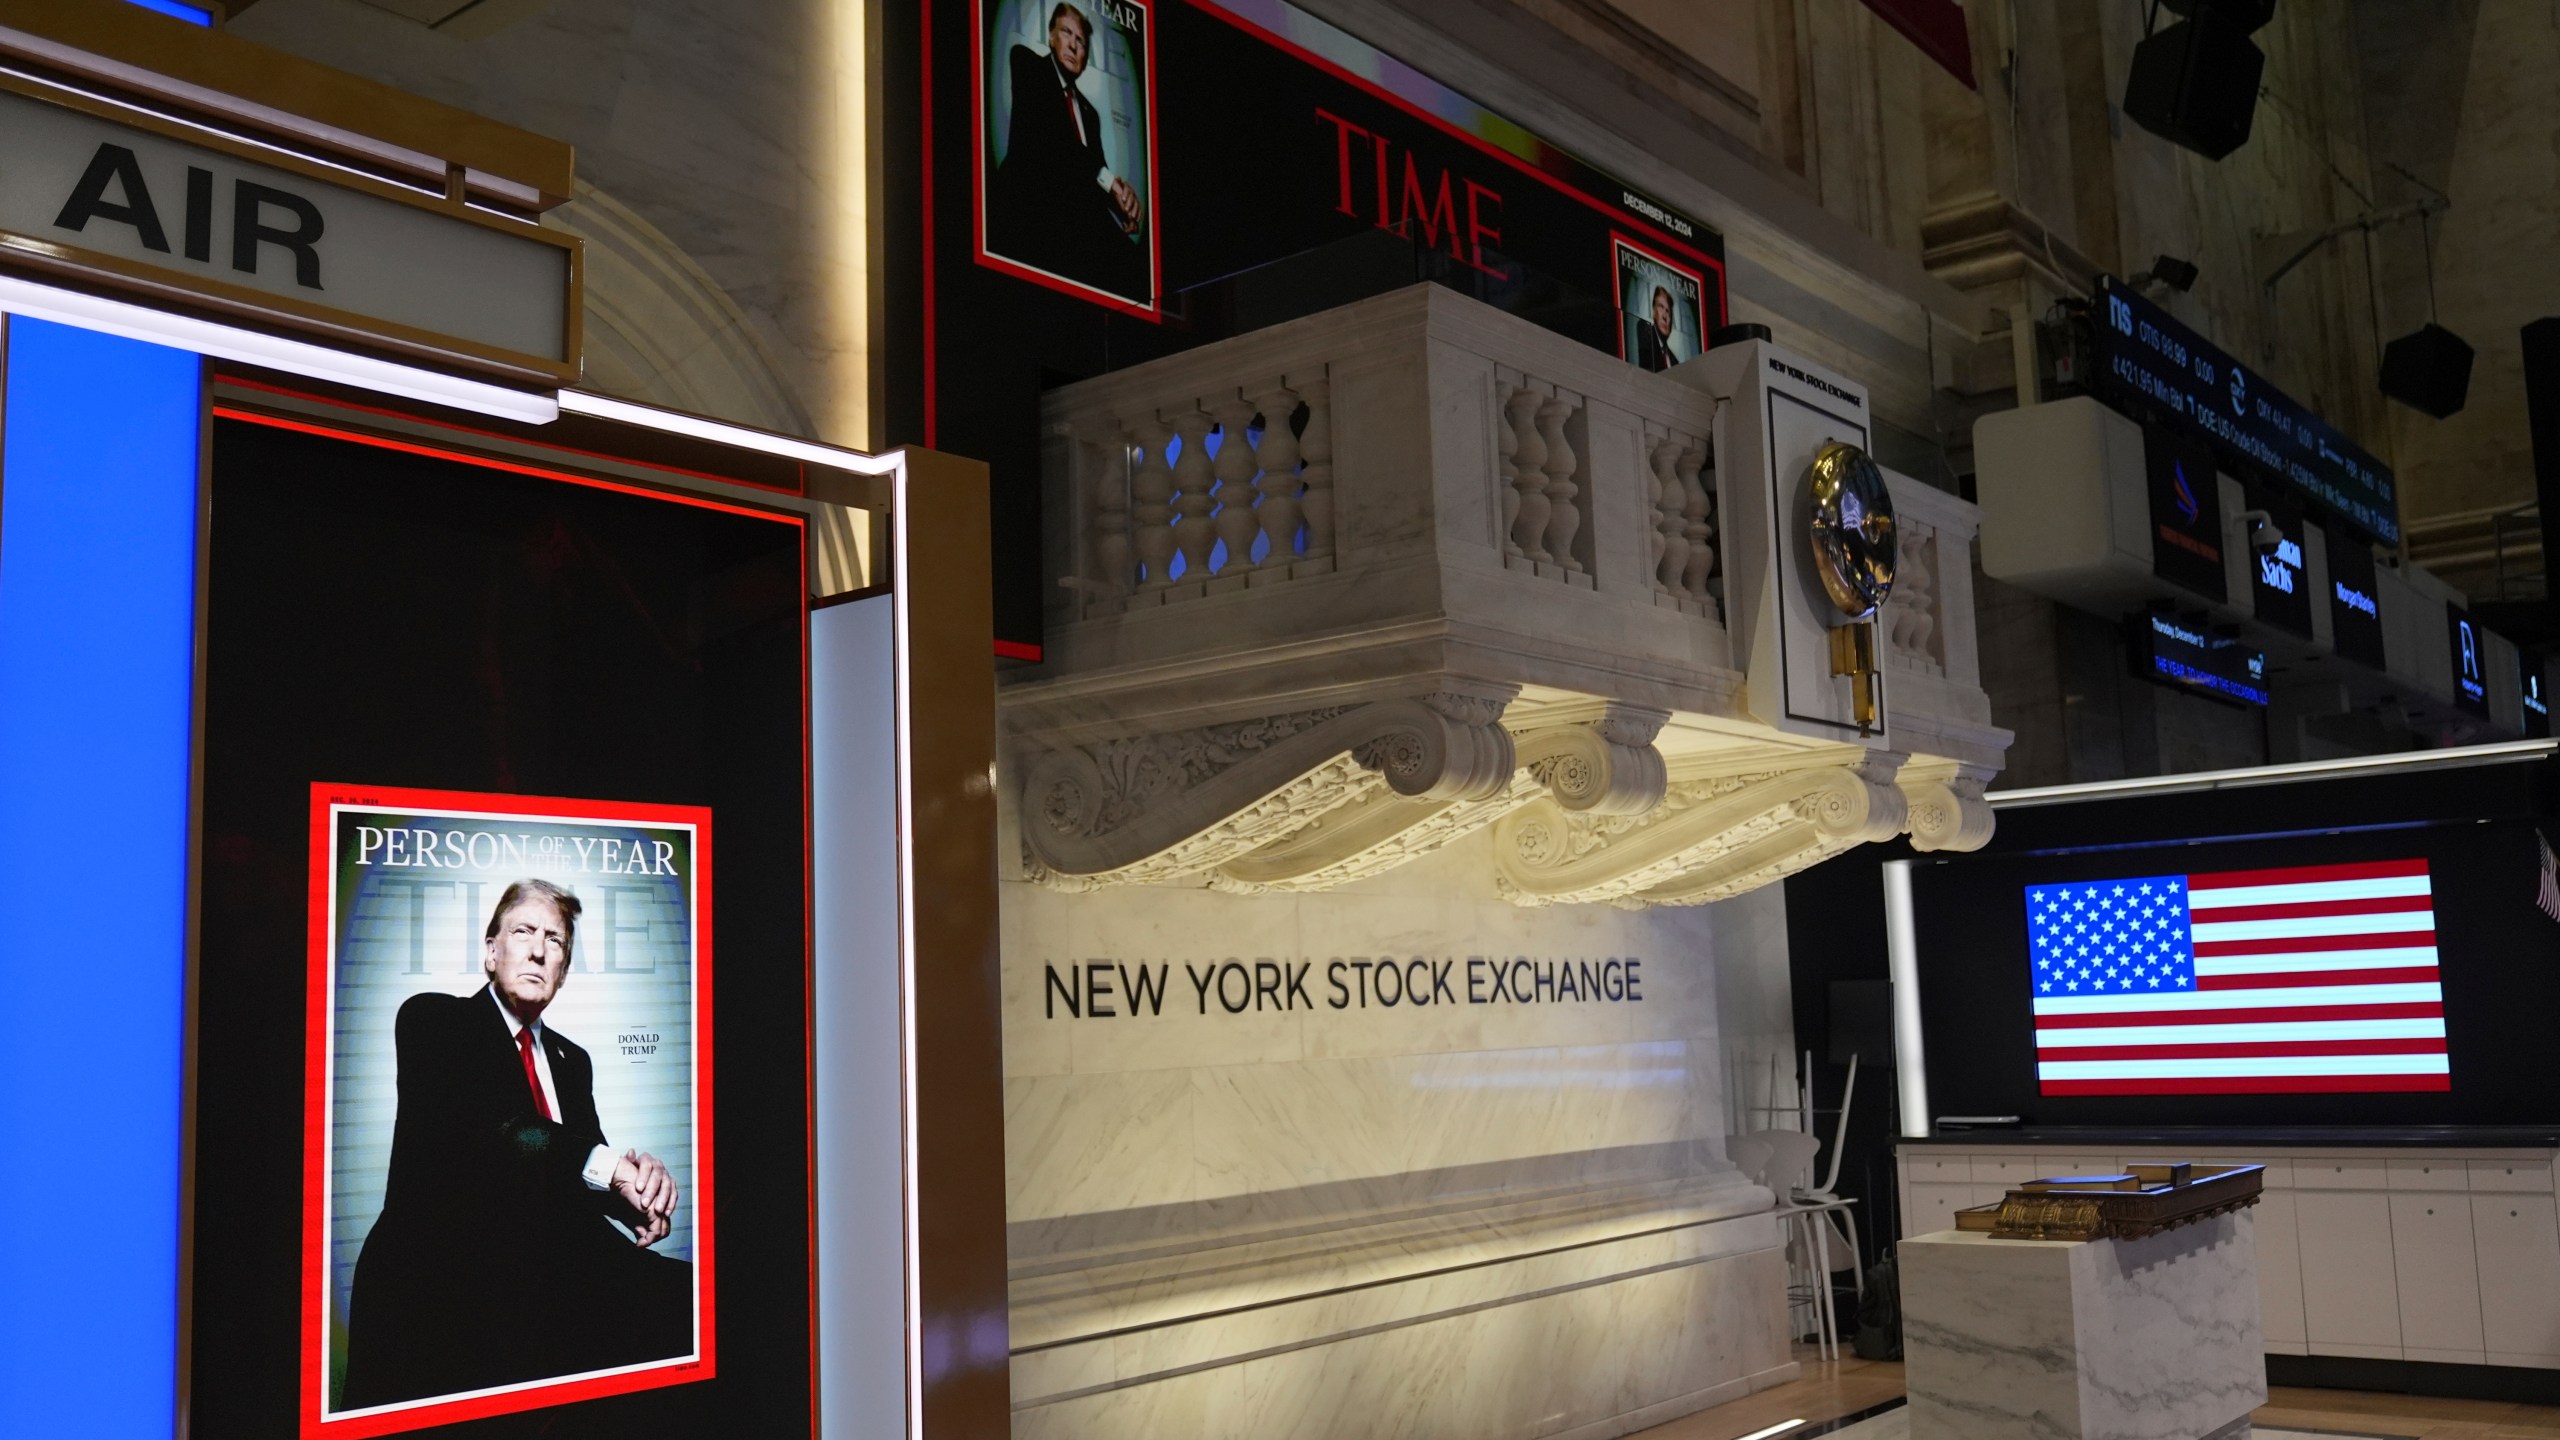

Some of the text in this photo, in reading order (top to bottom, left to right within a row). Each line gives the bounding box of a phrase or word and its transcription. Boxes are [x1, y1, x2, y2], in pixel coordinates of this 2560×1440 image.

[53, 142, 325, 291] AIR
[1315, 107, 1509, 281] TIME
[1623, 191, 1664, 224] DECEMBER
[1674, 218, 1693, 238] 2024
[1669, 273, 1697, 300] YEAR
[2139, 320, 2161, 351] OTIS
[1769, 357, 1862, 408] NEW YORK STOCK EXCHANGE
[2261, 553, 2293, 594] Sachs
[355, 826, 678, 875] PERSON OF THE YEAR
[1045, 959, 1644, 1019] NEW YORK STOCK EXCHANGE
[618, 1033, 660, 1044] DONALD
[620, 1045, 657, 1056] TRUMP
